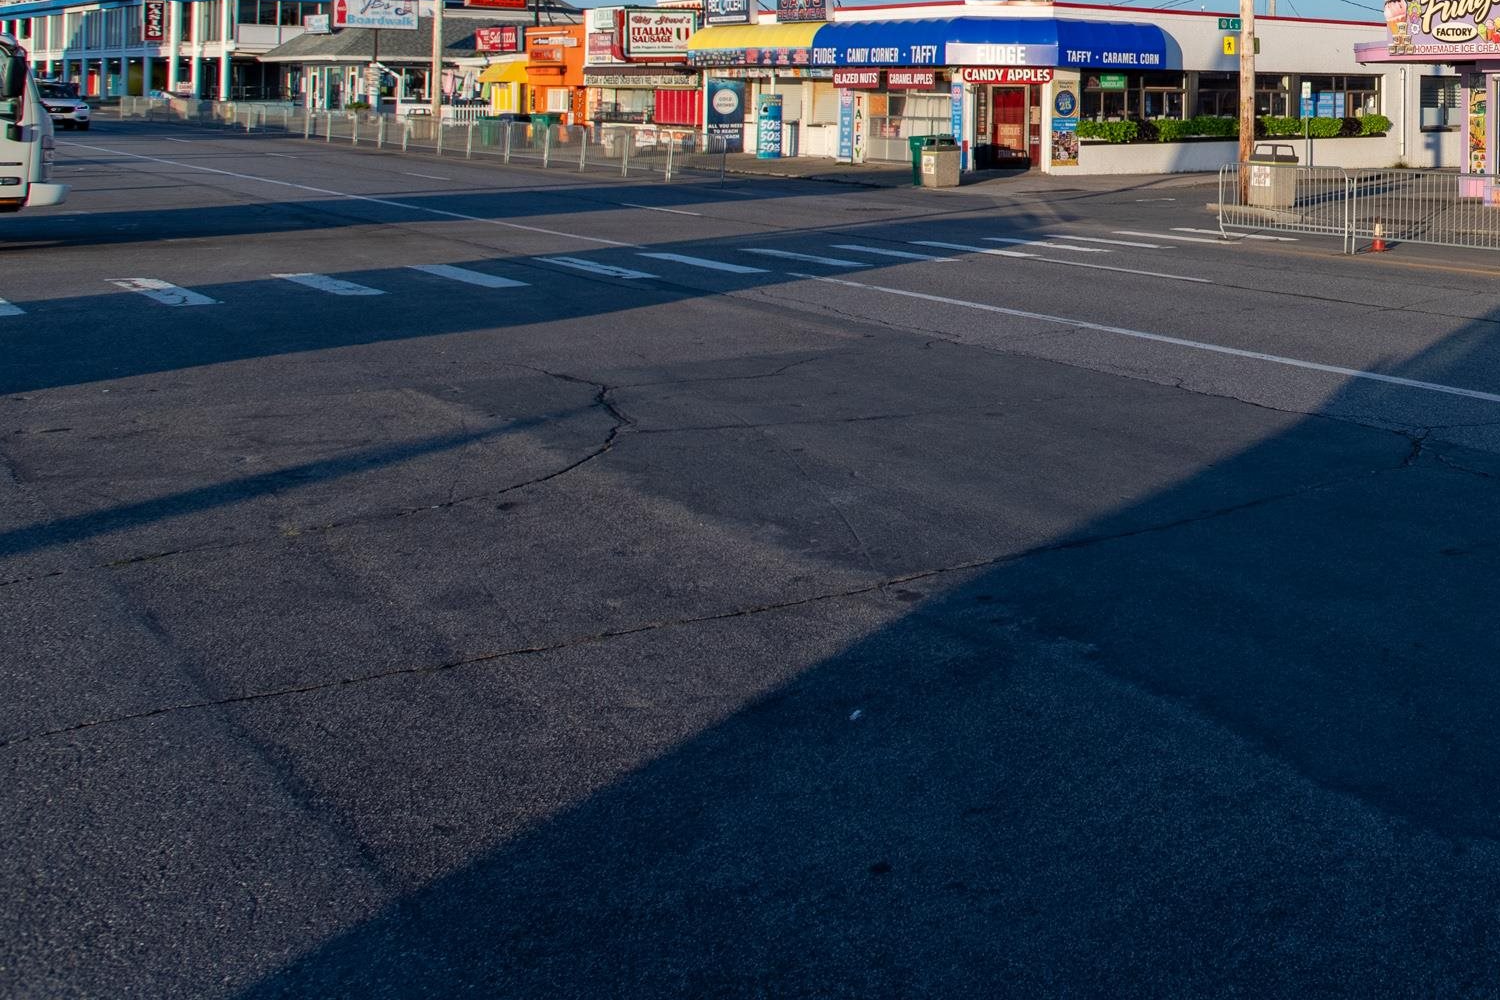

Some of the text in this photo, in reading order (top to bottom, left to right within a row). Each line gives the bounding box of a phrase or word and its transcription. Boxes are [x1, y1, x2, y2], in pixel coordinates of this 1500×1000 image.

[147, 3, 162, 37] CASINO
[347, 14, 414, 26] Boardwalk
[631, 27, 673, 35] ITALIAN
[1436, 27, 1473, 37] FACTORY
[631, 35, 673, 43] SAUSAGE
[813, 47, 837, 64] FUDGE
[847, 47, 869, 63] CANDY
[871, 47, 899, 63] CORNER
[911, 45, 937, 64] TAFFY
[1414, 43, 1460, 54] HOMEMADE
[1461, 43, 1475, 53] ICE
[976, 46, 1026, 64] FUDGE
[1066, 50, 1160, 65] TAFFY CARAMEL CORN
[834, 72, 877, 84] GLAZED NUTS
[889, 73, 933, 85] CARAMEL APPLES
[964, 68, 1050, 82] CANDY APPLES
[855, 96, 864, 158] TAFFY
